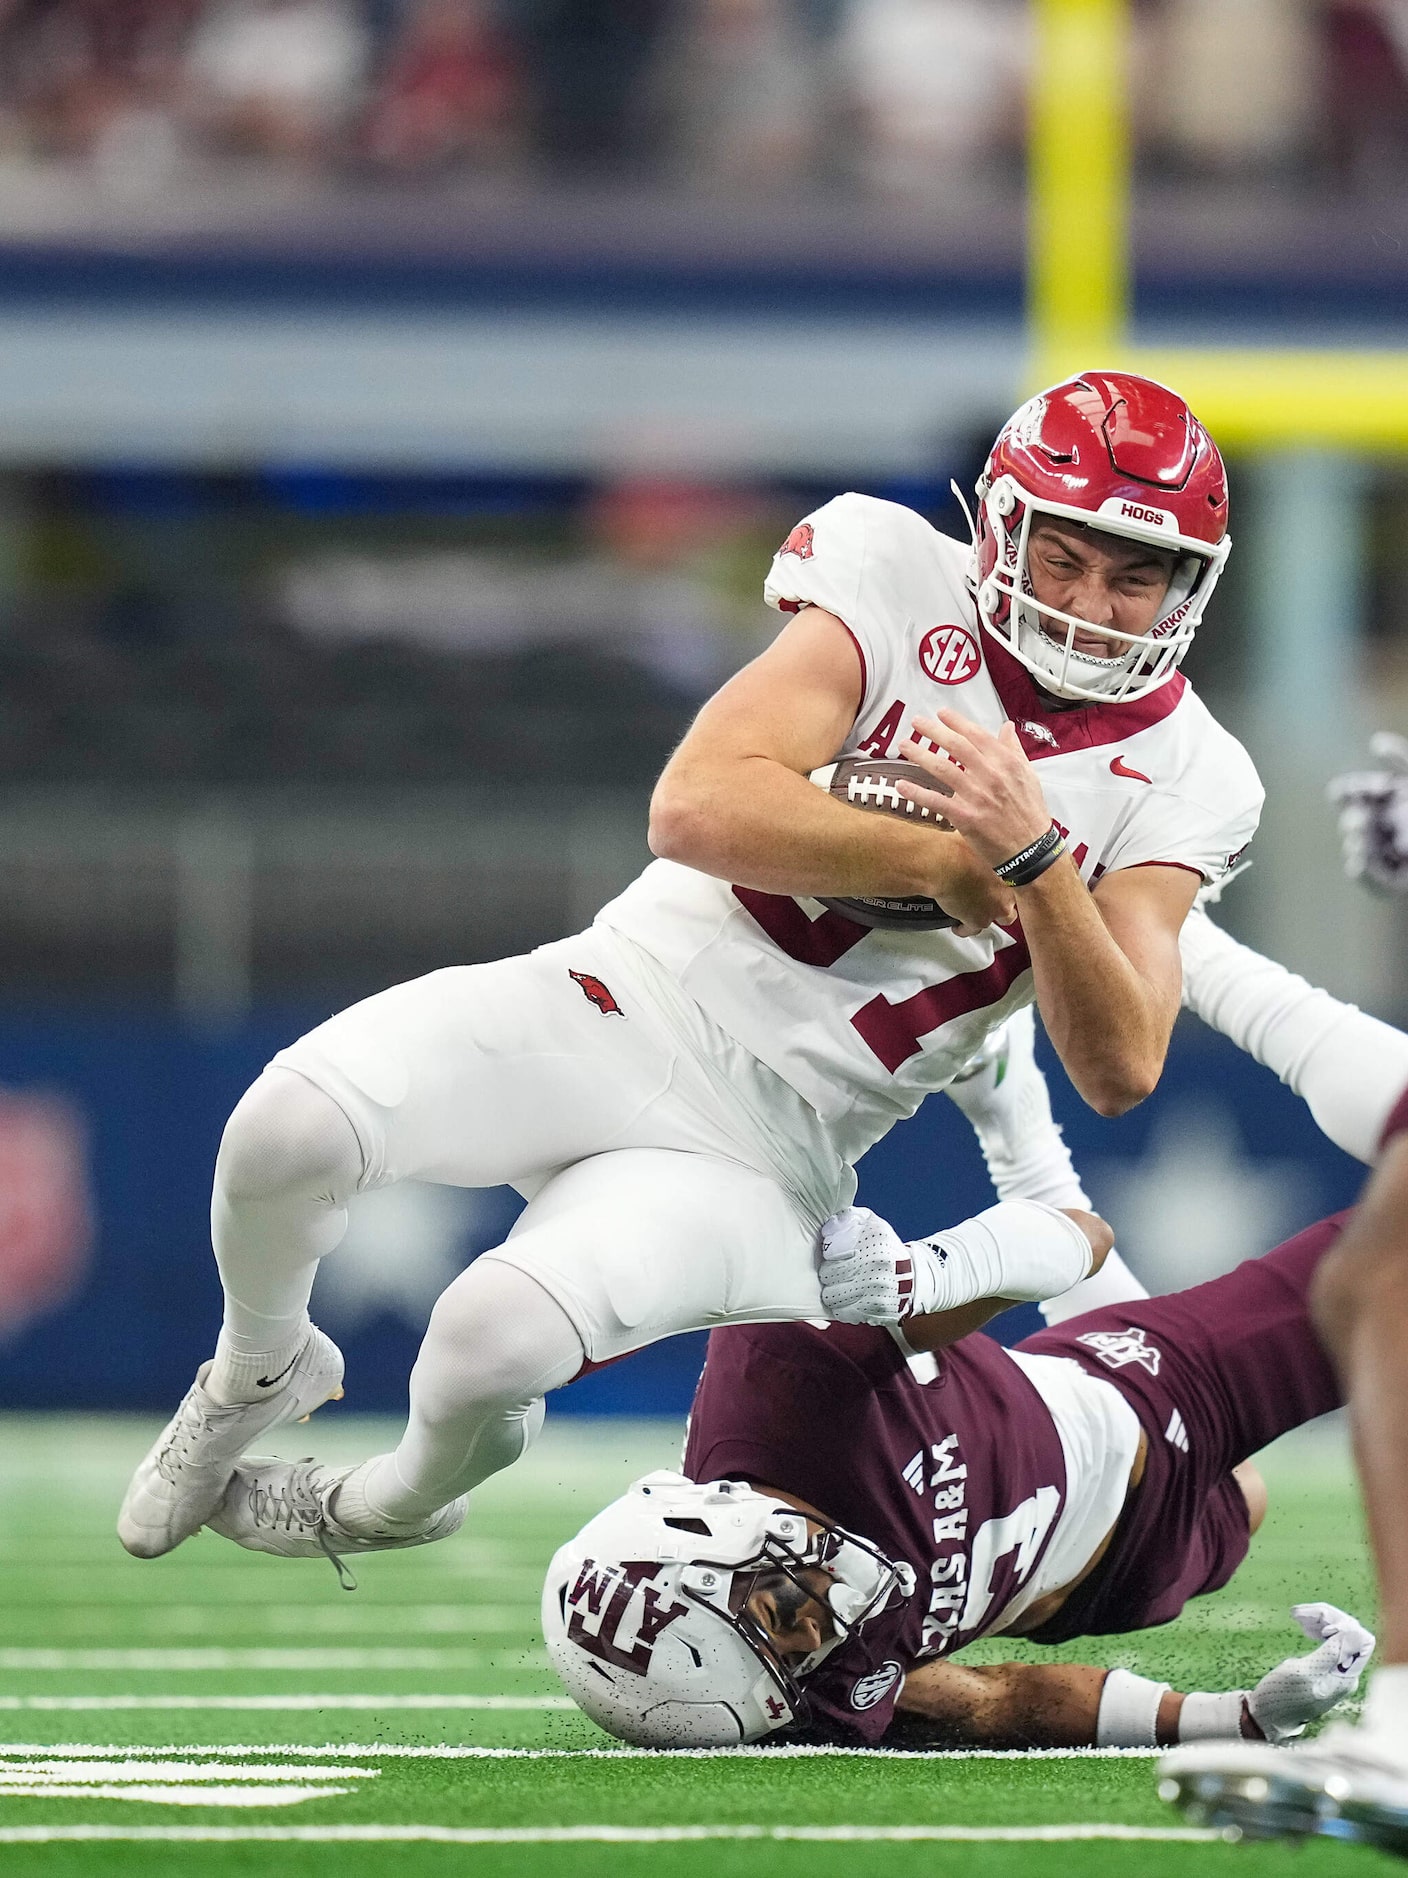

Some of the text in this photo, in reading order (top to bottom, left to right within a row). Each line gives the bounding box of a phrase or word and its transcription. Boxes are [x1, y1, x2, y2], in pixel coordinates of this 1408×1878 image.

[1120, 503, 1164, 526] HOGS
[922, 628, 977, 682] SEC
[887, 901, 934, 913] ELITE
[930, 1433, 968, 1545] A&M
